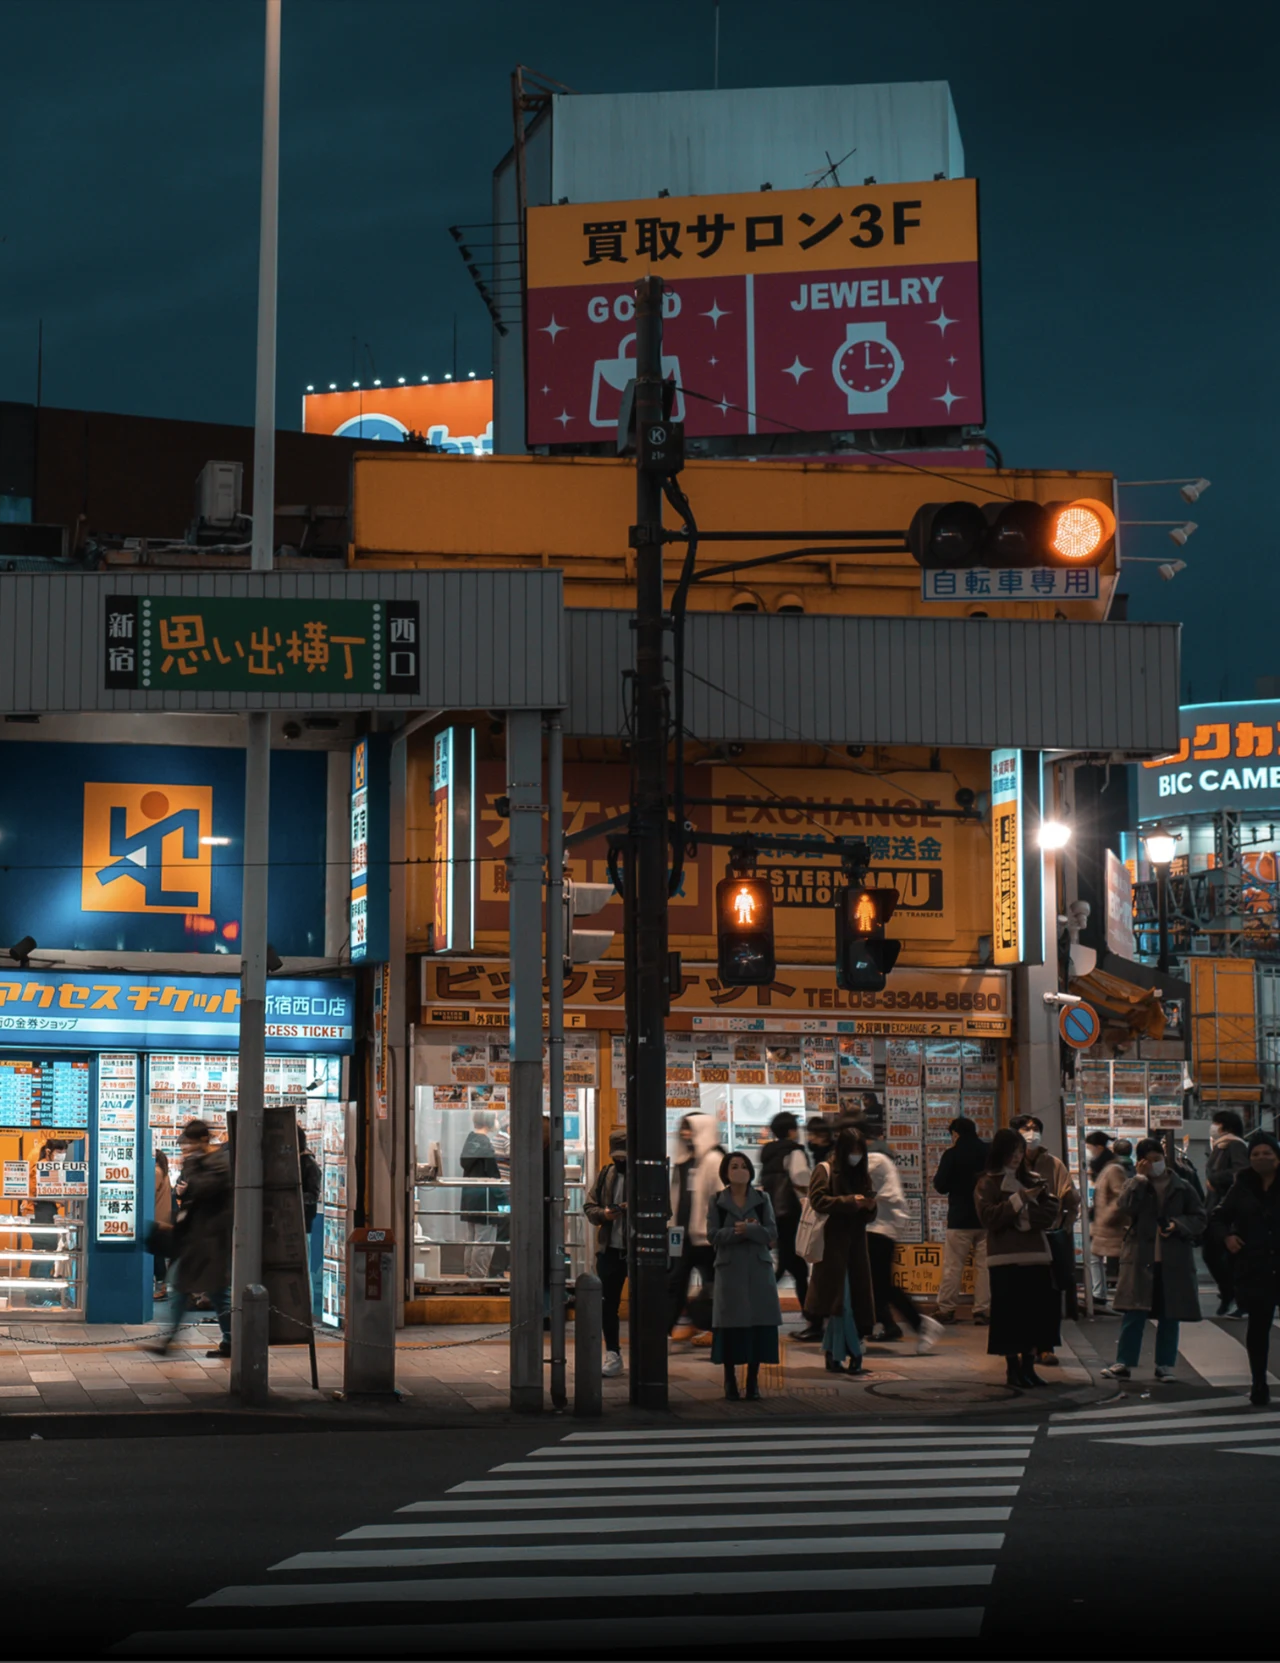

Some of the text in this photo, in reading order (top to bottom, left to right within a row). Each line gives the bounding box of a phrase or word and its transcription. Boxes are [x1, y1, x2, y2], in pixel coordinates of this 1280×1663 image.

[582, 199, 923, 267] 買取サロン3F
[790, 275, 945, 312] JEWELRY
[587, 291, 682, 324] GOD
[933, 569, 1090, 595] 自転車専用
[108, 612, 135, 673] 新宿
[159, 614, 367, 680] 思い出横丁
[389, 616, 416, 677] 西口
[1158, 772, 1194, 798] BIC
[725, 795, 942, 829] EXCHANGE
[770, 886, 844, 906] UNIO
[264, 1024, 345, 1038] CCESS TICKET
[100, 1100, 123, 1109] ANA
[40, 1130, 57, 1139] NO
[62, 1162, 88, 1171] EUR
[108, 1147, 134, 1161] 小田原
[107, 1200, 134, 1214] 橋本
[925, 1281, 941, 1293] floo
